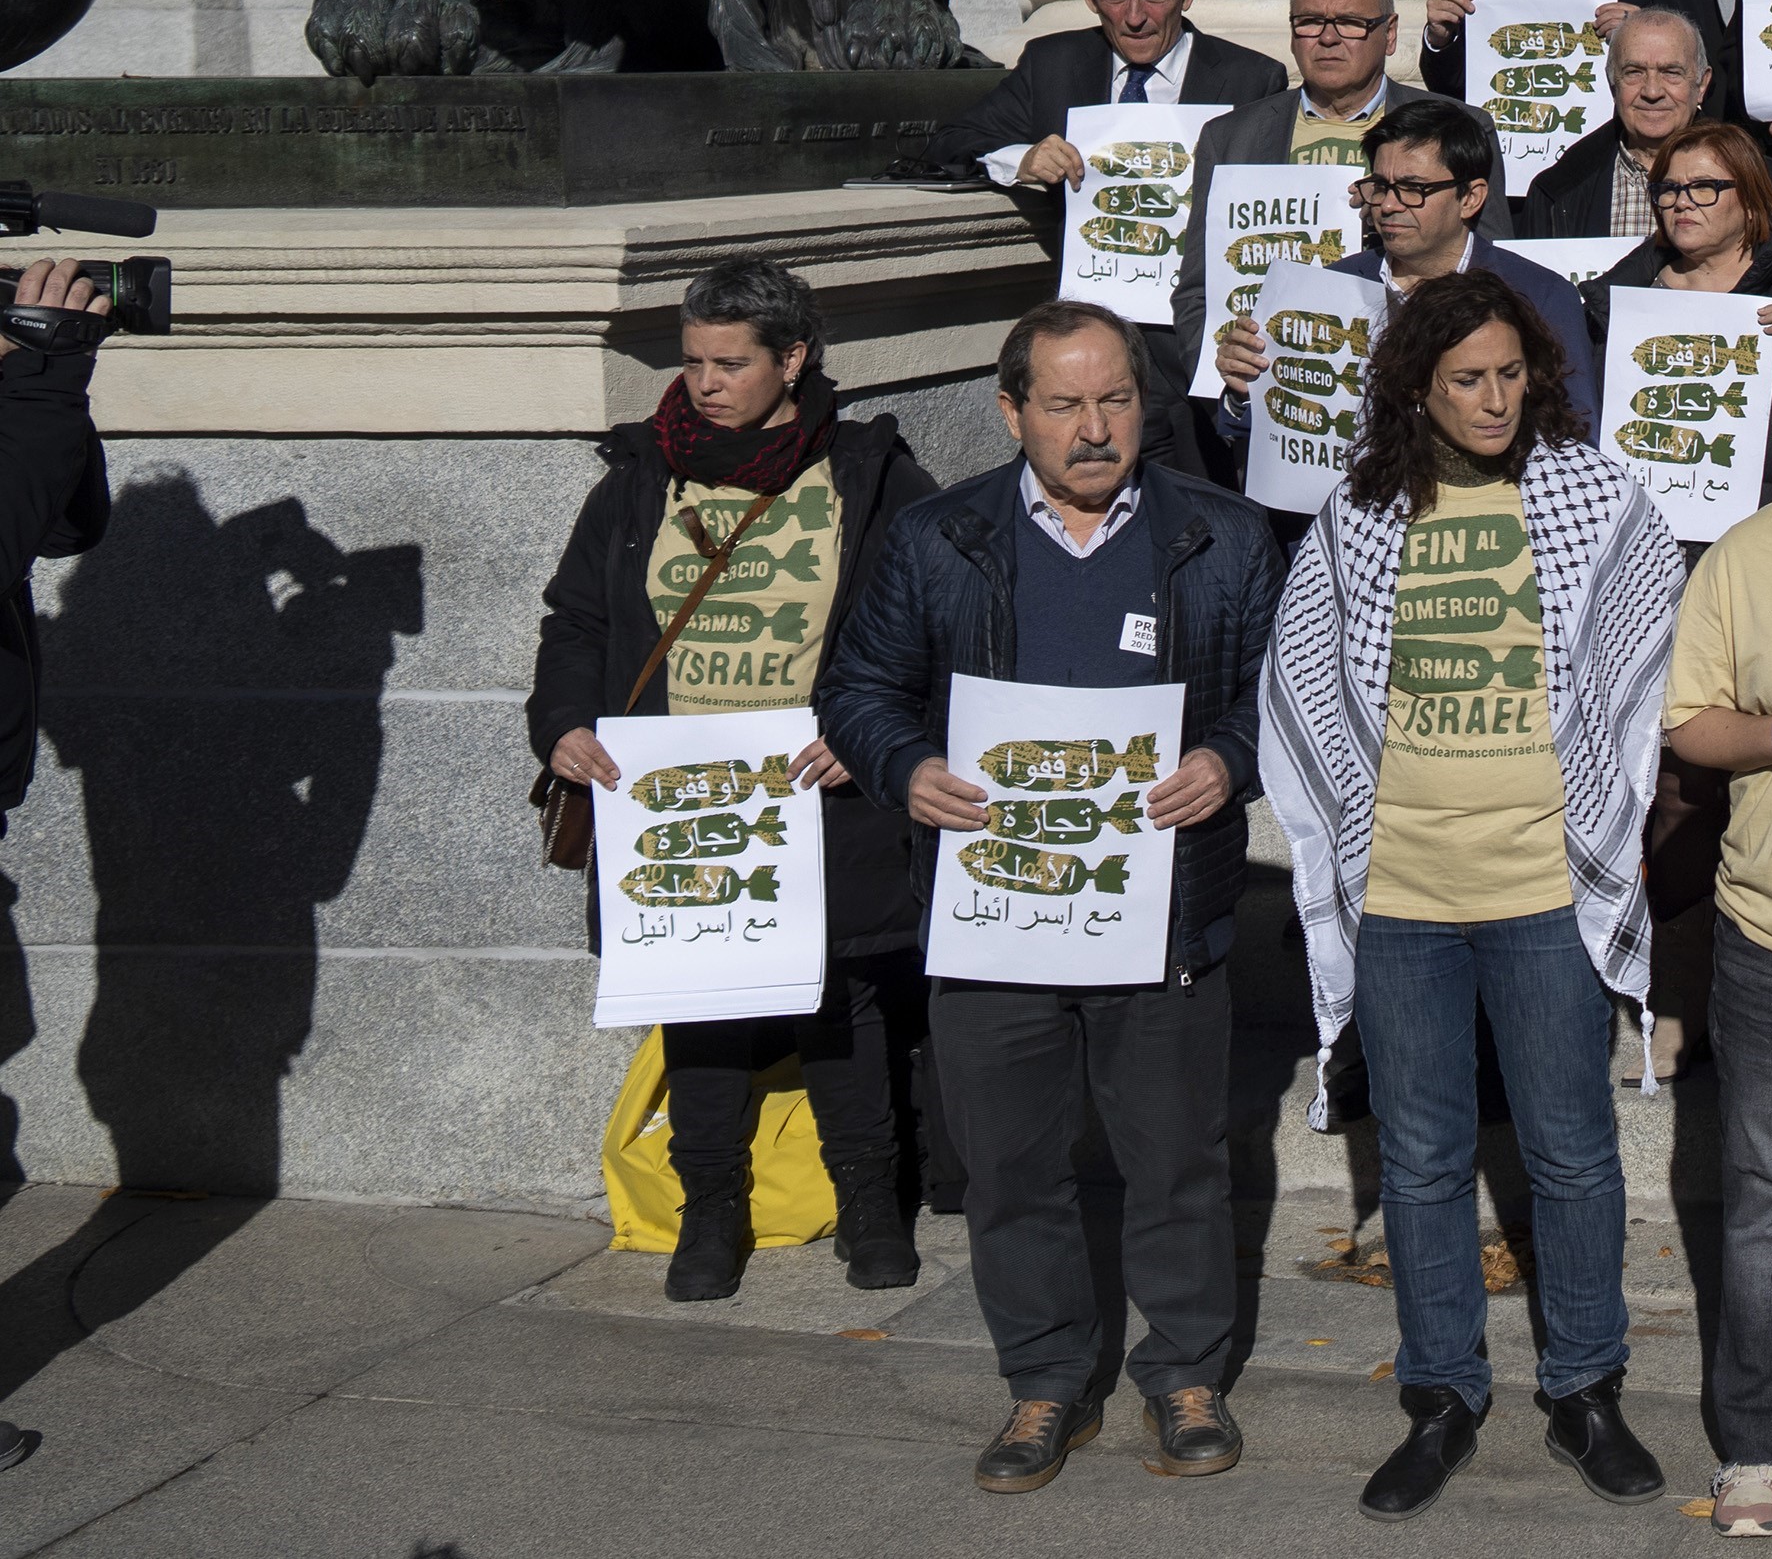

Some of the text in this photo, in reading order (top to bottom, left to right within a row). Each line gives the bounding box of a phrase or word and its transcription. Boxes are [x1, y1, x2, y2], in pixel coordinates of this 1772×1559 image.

[1506, 70, 1564, 95] تجارة
[1228, 193, 1320, 230] ISRAELÍ
[1241, 240, 1303, 266] ARMAK
[11, 316, 48, 330] Canon
[1282, 317, 1313, 346] FIN
[1277, 363, 1333, 388] COMERCIO
[1647, 388, 1710, 419] تجارة
[1624, 427, 1698, 458] الأسلحة
[1703, 477, 1730, 501] مع
[1409, 528, 1499, 567] FIN AL
[1403, 696, 1532, 736] ISRAEL
[657, 816, 741, 860] تجارة
[1002, 803, 1092, 840] تجارة
[971, 847, 1076, 888] الأسلحة
[952, 889, 1122, 936] مع إسرائيل
[621, 912, 778, 947] مع إسرائيل
